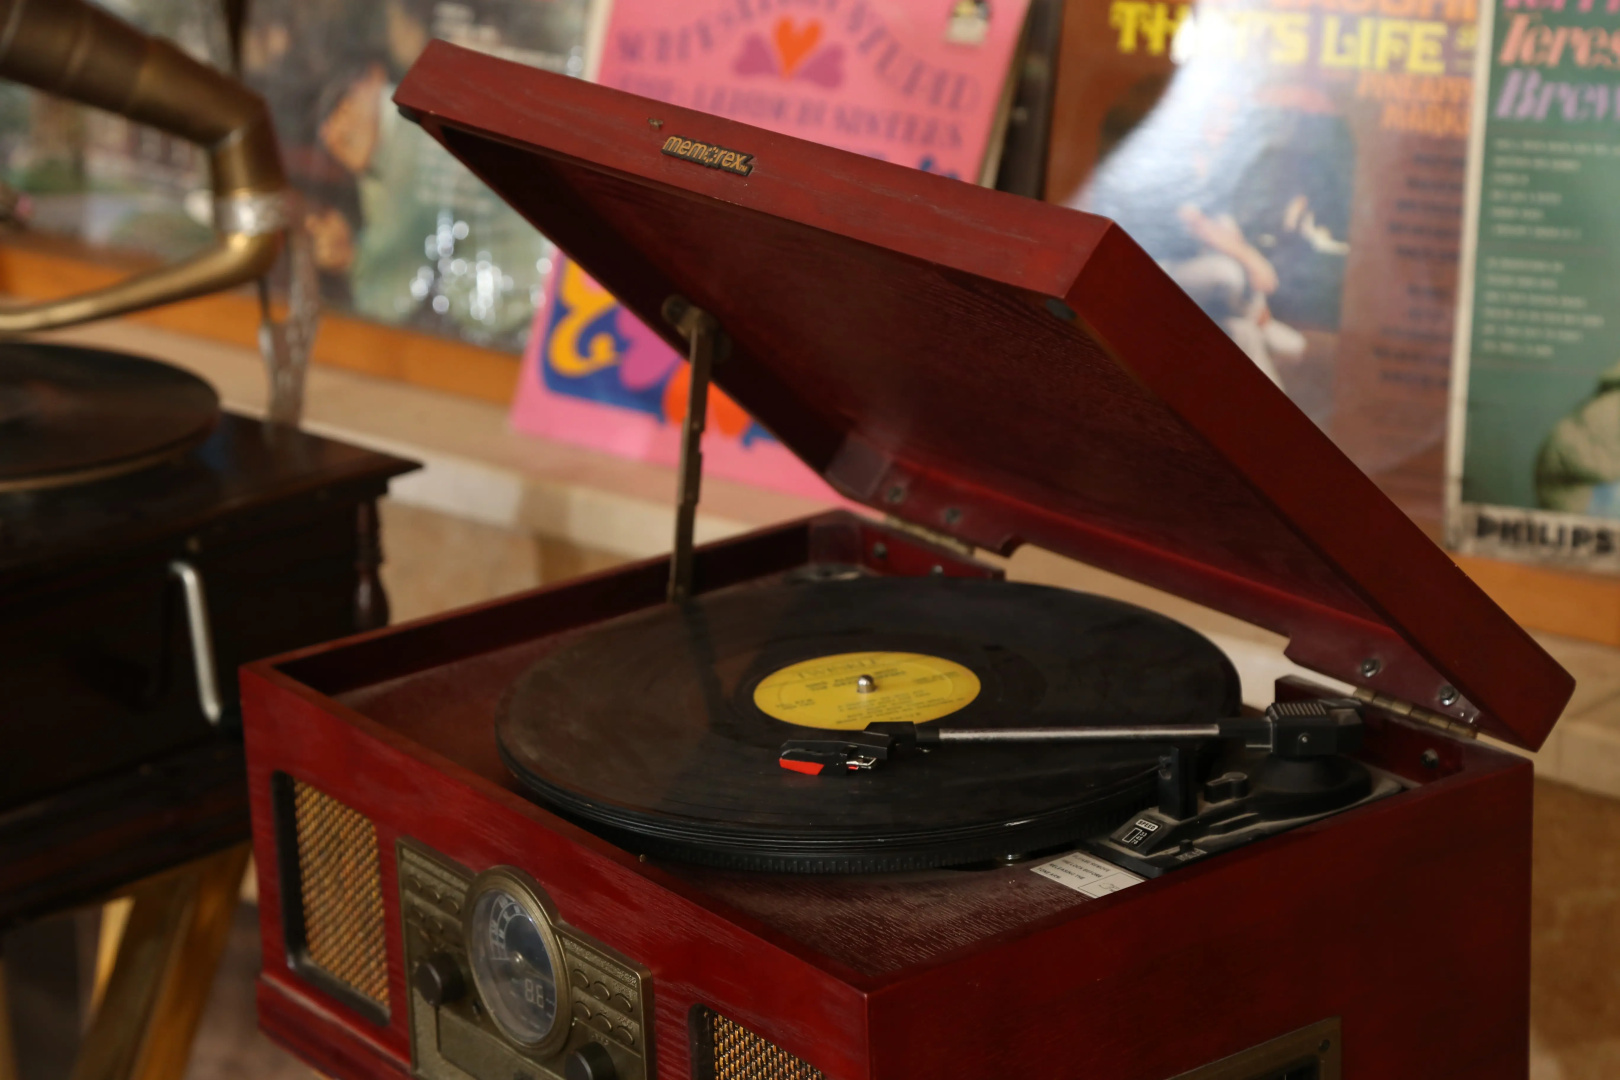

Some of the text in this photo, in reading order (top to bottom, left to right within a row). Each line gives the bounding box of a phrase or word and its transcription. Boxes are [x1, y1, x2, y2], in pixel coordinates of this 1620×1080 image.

[1109, 2, 1448, 75] THT'S LIFE
[662, 136, 747, 171] memorex
[1476, 515, 1614, 554] PHILIPS
[1137, 819, 1156, 830] SPEED
[1049, 863, 1075, 876] RELEASING
[1082, 868, 1102, 878] BEFORE
